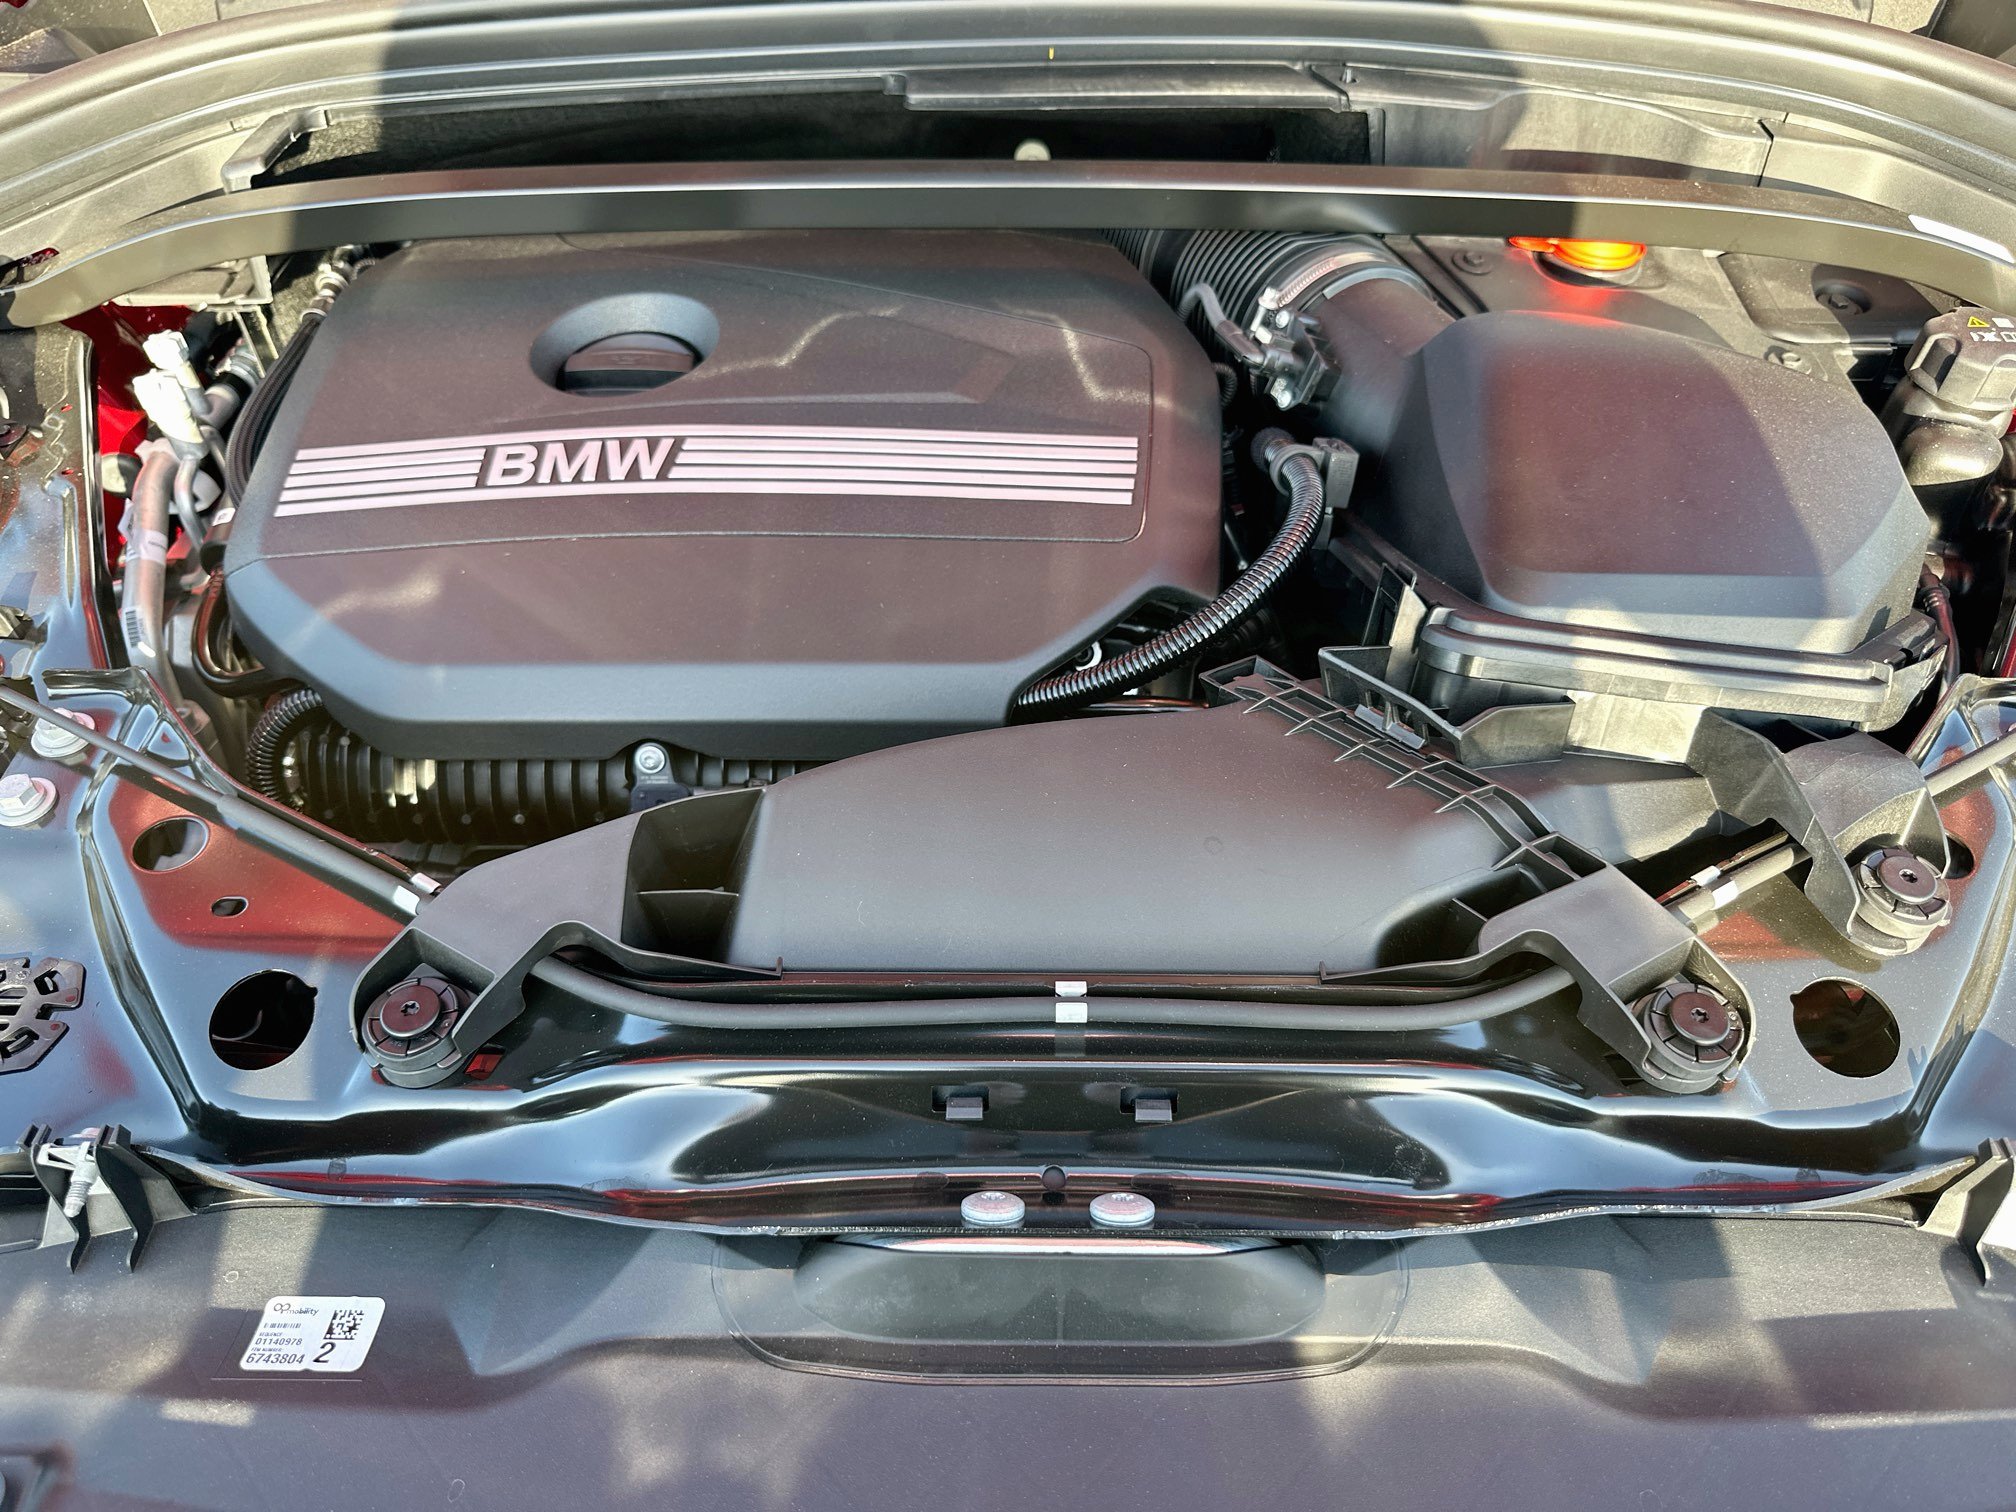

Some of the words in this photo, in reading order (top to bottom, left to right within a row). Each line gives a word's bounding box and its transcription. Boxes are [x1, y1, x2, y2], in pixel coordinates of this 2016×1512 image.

[486, 437, 675, 486] BMW
[255, 1337, 302, 1346] 01140978
[246, 1353, 305, 1364] 6743804
[312, 1341, 337, 1363] 2
